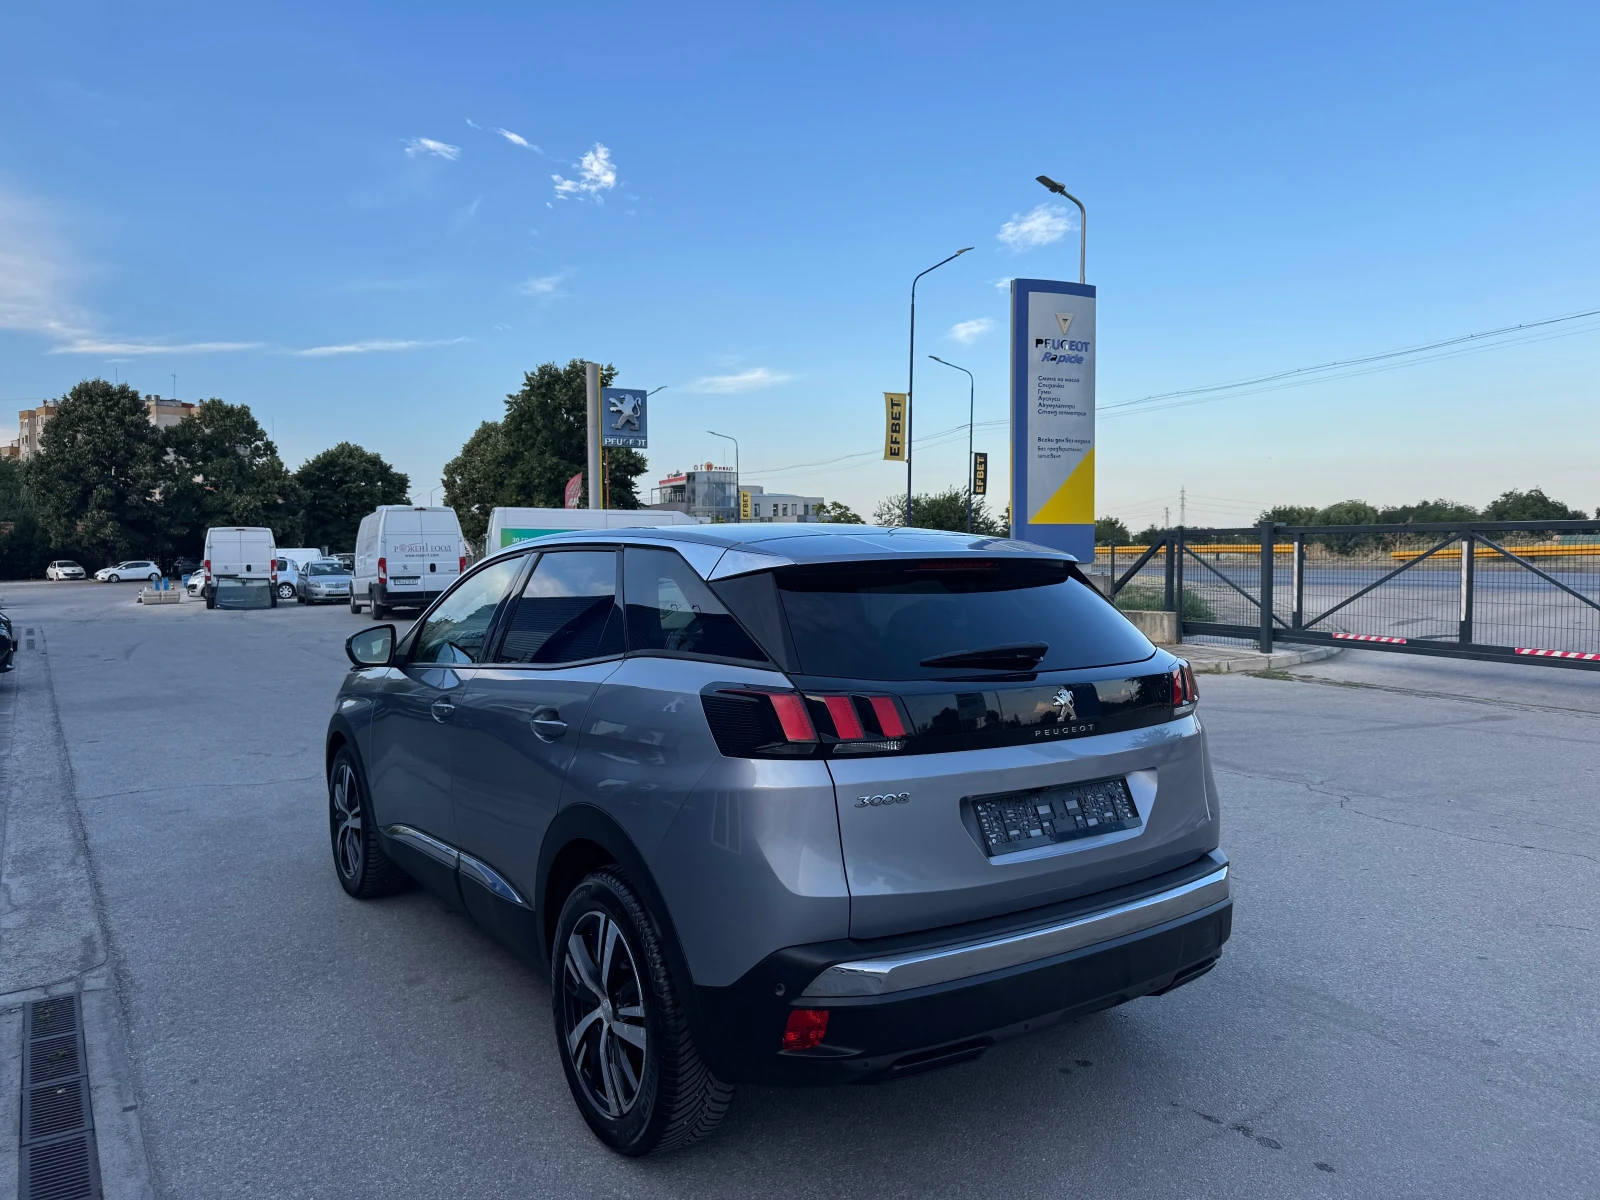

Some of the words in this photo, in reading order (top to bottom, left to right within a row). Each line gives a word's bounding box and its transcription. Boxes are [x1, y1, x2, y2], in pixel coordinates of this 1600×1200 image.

[1035, 338, 1090, 352] PEUGEOT
[1041, 352, 1084, 364] Rapide
[1037, 382, 1065, 390] Спирачки
[1037, 402, 1076, 410] Акумулатори
[889, 397, 901, 456] EFBET
[975, 455, 985, 493] EFBET
[1034, 724, 1095, 737] PEUGEOT
[854, 792, 910, 808] 3008
